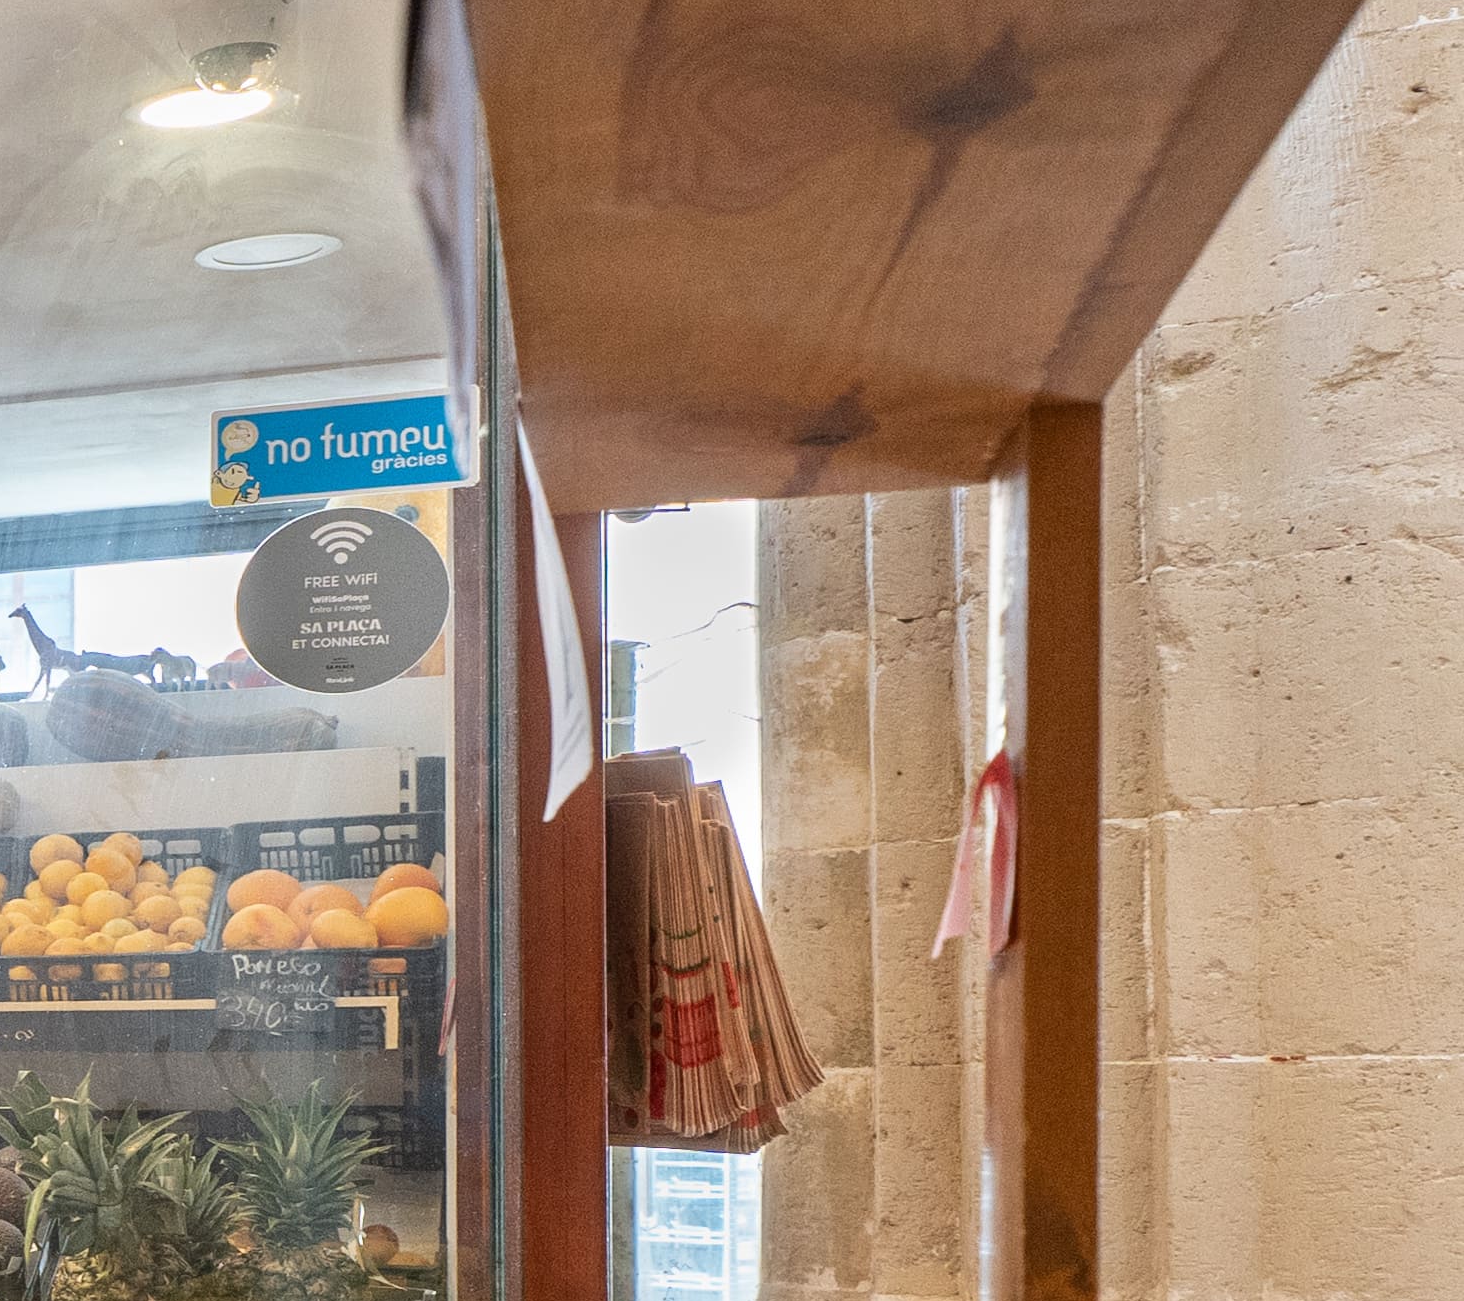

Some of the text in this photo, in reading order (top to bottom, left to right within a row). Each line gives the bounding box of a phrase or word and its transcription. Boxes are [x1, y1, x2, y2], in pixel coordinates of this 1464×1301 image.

[266, 422, 448, 466] no fumeu
[371, 451, 448, 476] gràcies
[304, 575, 340, 589] FREE
[299, 618, 382, 635] SA PLAÇA
[292, 639, 308, 650] ET
